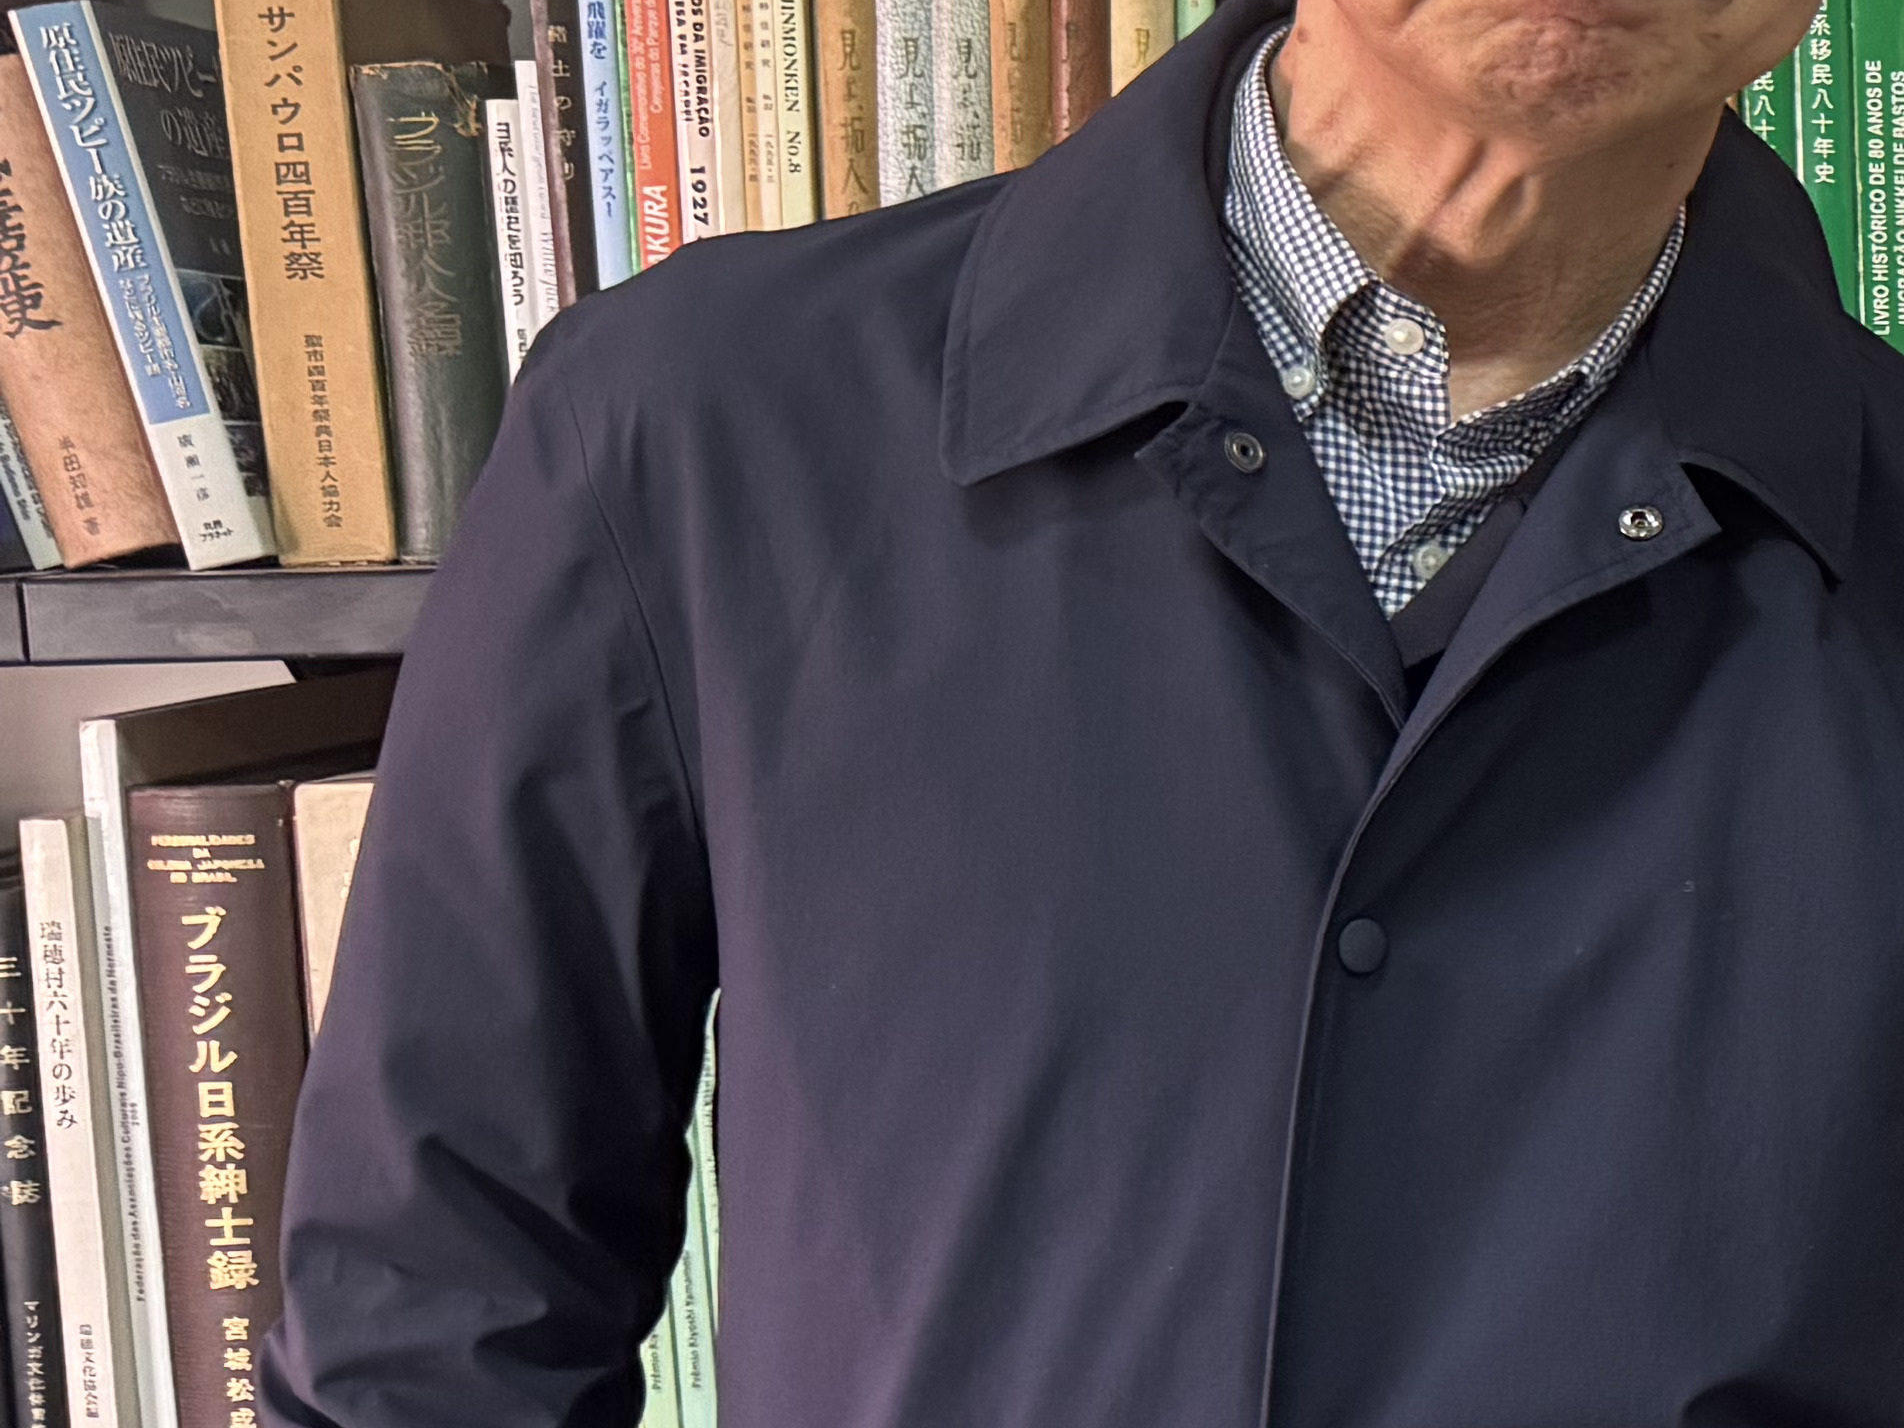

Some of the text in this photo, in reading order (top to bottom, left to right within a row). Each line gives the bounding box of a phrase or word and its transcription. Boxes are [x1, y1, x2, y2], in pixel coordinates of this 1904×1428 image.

[694, 23, 705, 44] DA
[694, 49, 711, 137] IMIGRAÇÃO
[40, 22, 145, 271] 原住民ツピー族の遺産
[259, 6, 325, 282] サンパウロ四百年祭
[690, 166, 709, 226] 1927
[787, 130, 802, 173] No.8
[1866, 60, 1890, 335] LIVRO HISTÓRICO DE 80 ANOS DE
[40, 921, 80, 1131] 瑞穂村六十年の歩み
[181, 907, 260, 1292] ブラジル日系紳士録
